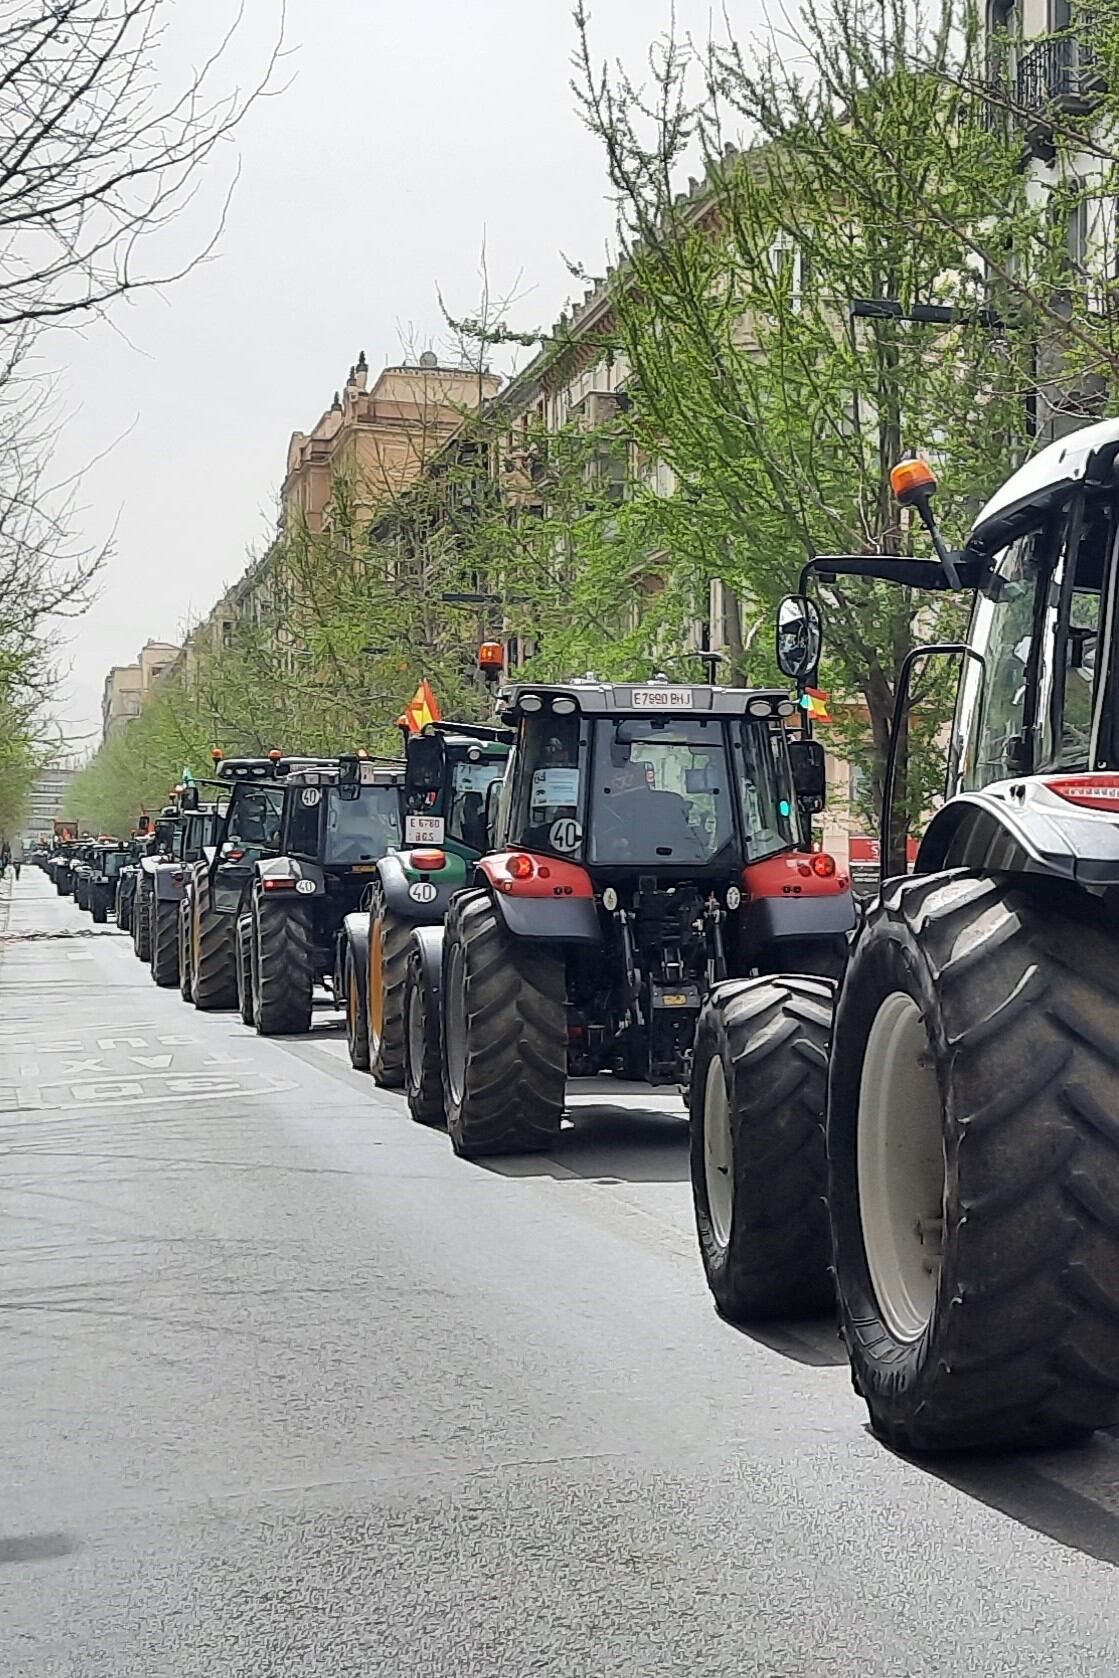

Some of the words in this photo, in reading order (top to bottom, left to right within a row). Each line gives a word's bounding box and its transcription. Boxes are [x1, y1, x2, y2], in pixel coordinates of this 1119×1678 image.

[303, 789, 317, 804] 40
[554, 822, 576, 848] 40
[412, 884, 428, 900] 40
